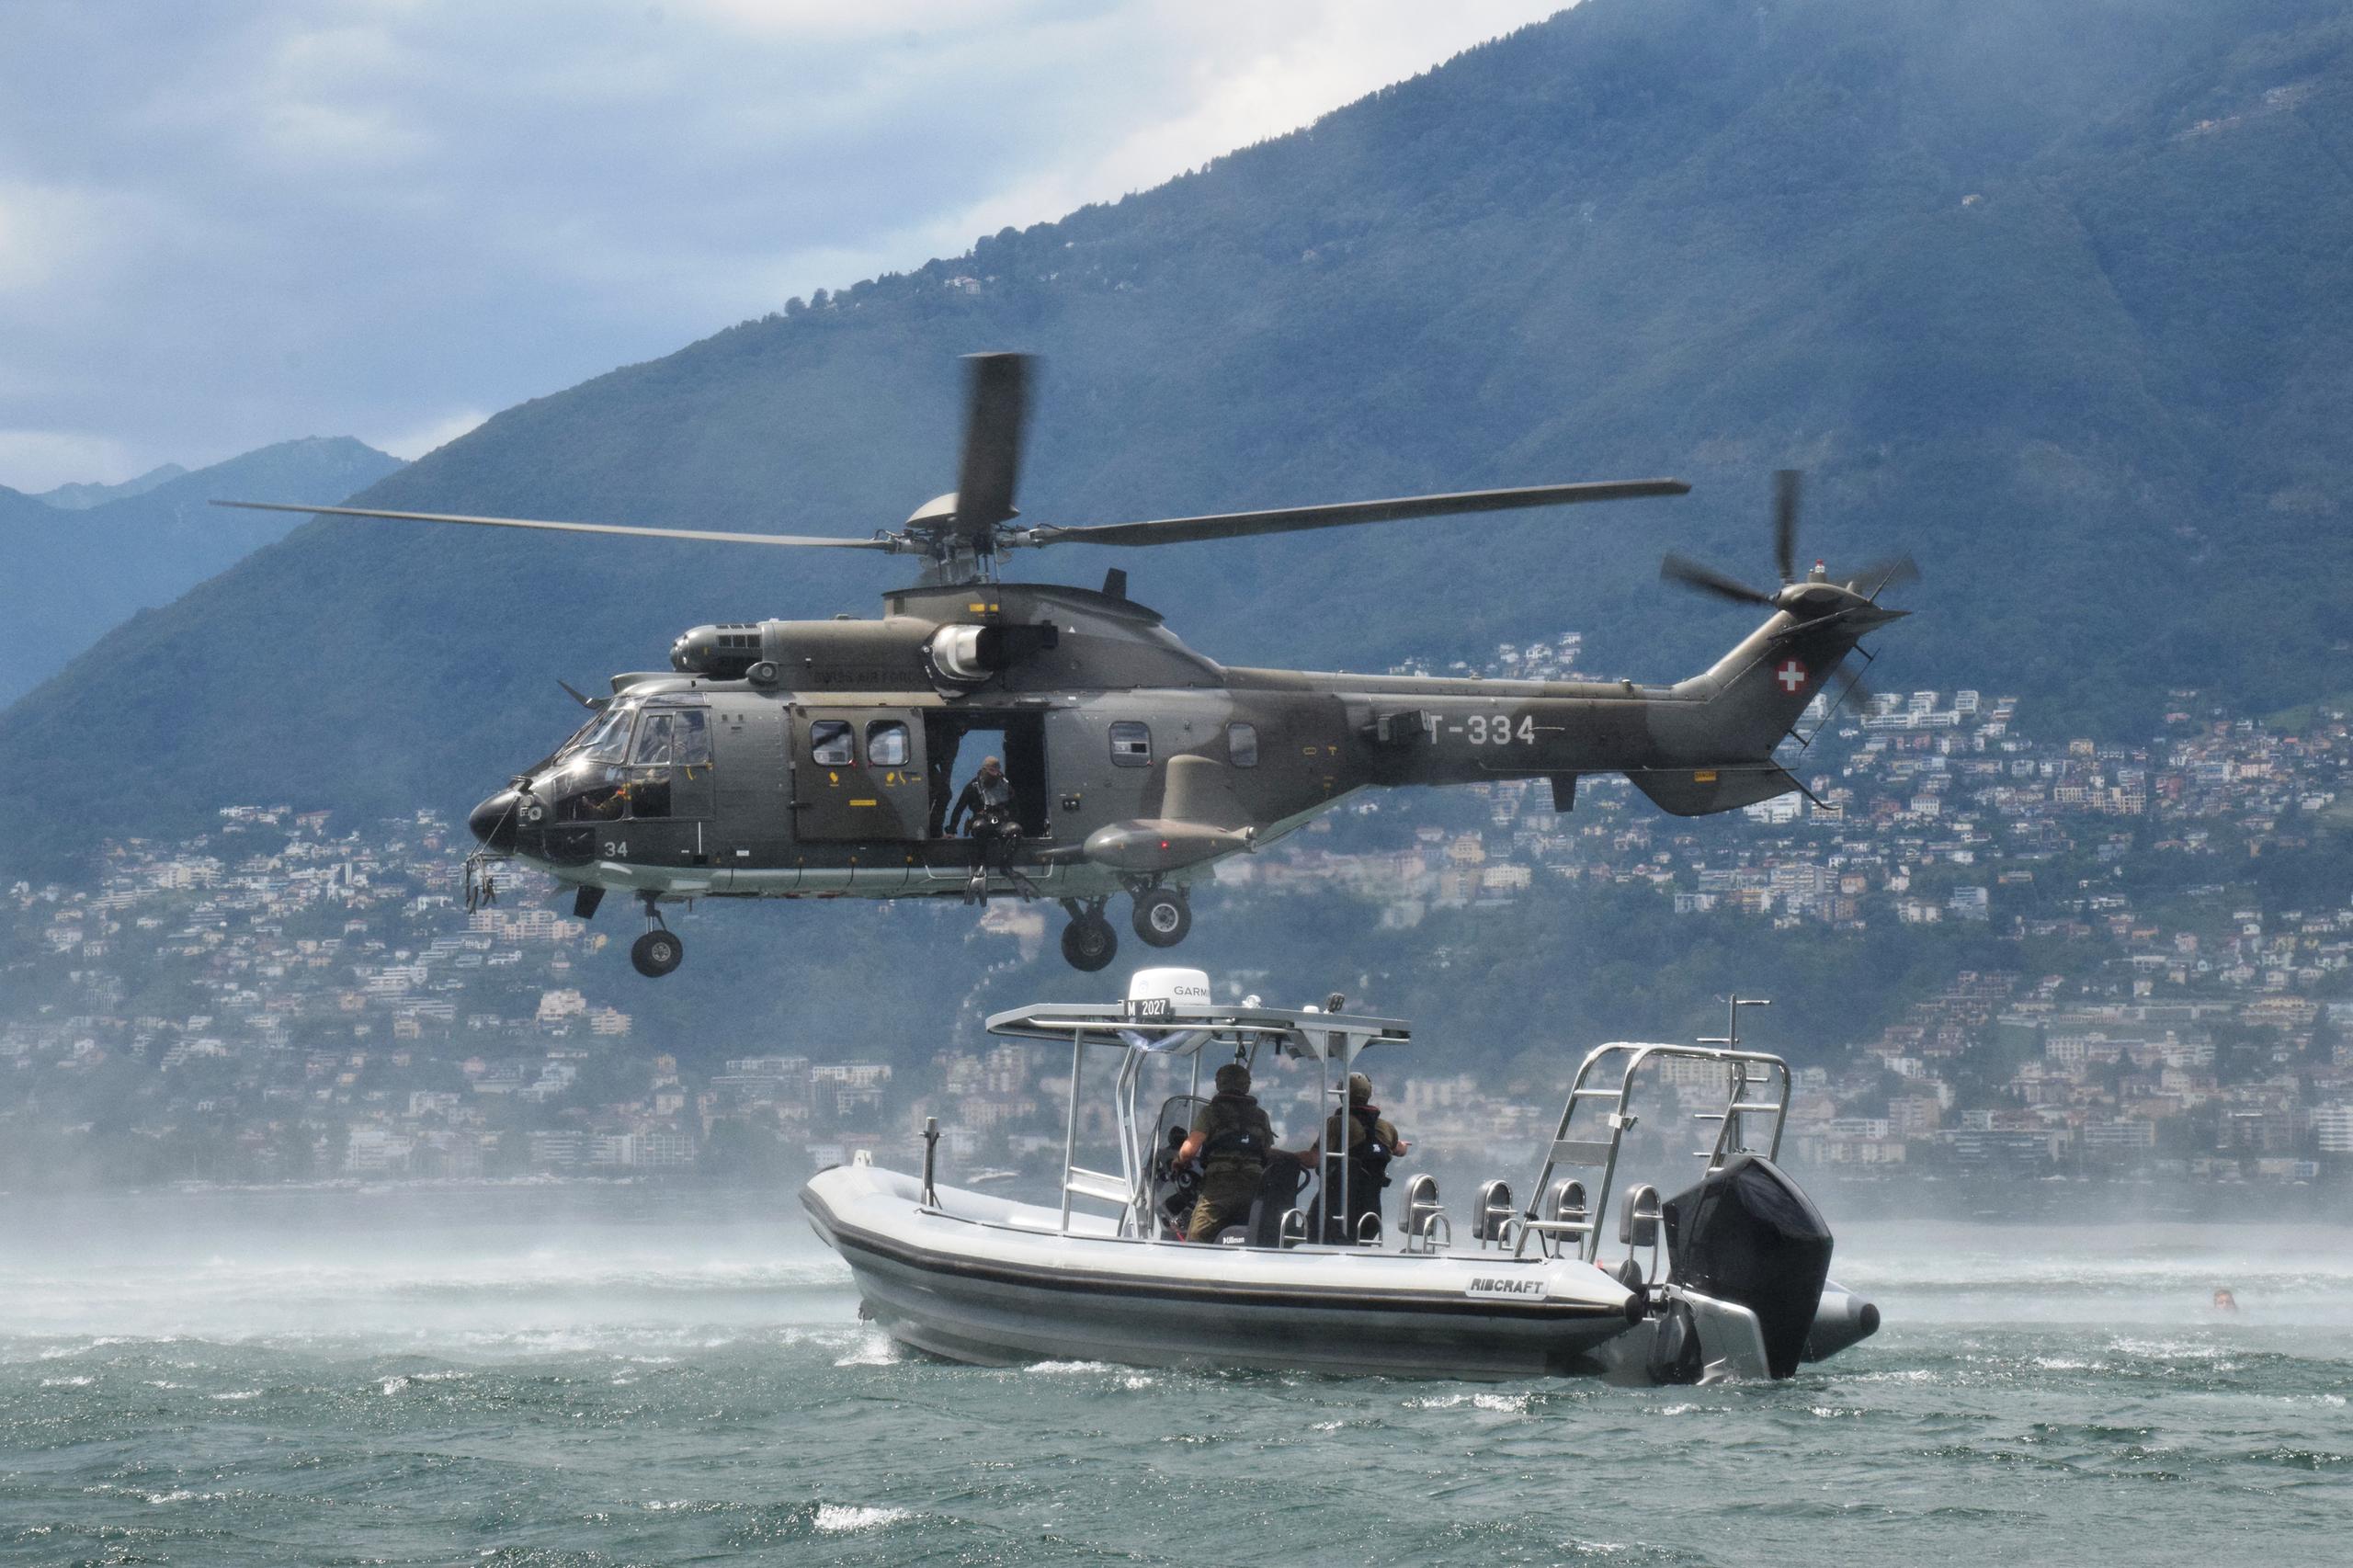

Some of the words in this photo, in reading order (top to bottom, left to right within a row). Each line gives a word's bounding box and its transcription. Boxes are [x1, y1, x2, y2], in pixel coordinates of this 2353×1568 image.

[857, 671, 879, 684] AIR
[1430, 714, 1535, 744] T-334
[604, 841, 628, 857] 34
[1174, 985, 1208, 997] GARM
[1128, 1001, 1136, 1016] M
[1142, 999, 1165, 1015] 2027
[1471, 1278, 1544, 1294] RIBCRAFT
